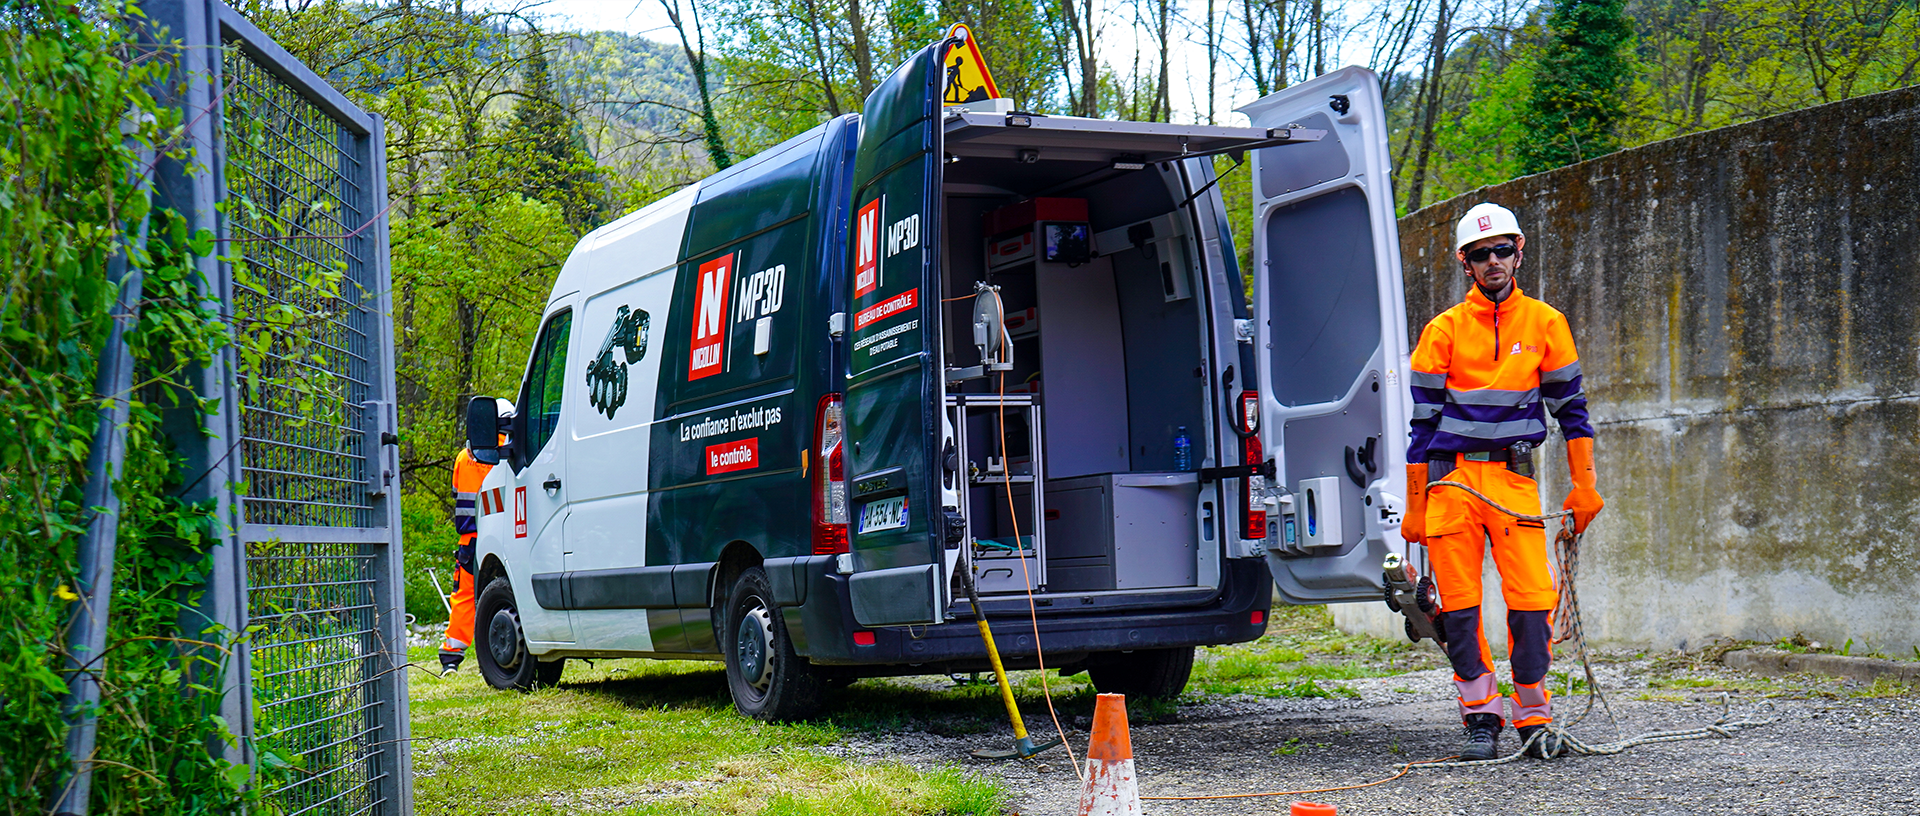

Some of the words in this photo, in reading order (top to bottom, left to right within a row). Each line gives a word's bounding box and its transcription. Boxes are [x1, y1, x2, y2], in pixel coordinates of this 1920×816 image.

[887, 213, 920, 258] MP3D
[1480, 216, 1490, 227] N
[859, 209, 875, 267] N
[697, 266, 726, 340] N
[737, 263, 786, 323] MP3D
[858, 308, 876, 326] BUREAU
[875, 305, 883, 318] DE
[883, 294, 912, 315] CONTRÔLE
[911, 319, 919, 330] ET
[691, 342, 721, 371] NICOLLIN
[680, 422, 690, 442] La
[691, 416, 729, 440] confiance
[730, 406, 764, 432] n’exclut
[764, 406, 782, 431] pas
[711, 451, 719, 468] le
[719, 445, 752, 466] contrôle
[858, 477, 888, 494] MASTER
[517, 490, 525, 522] N
